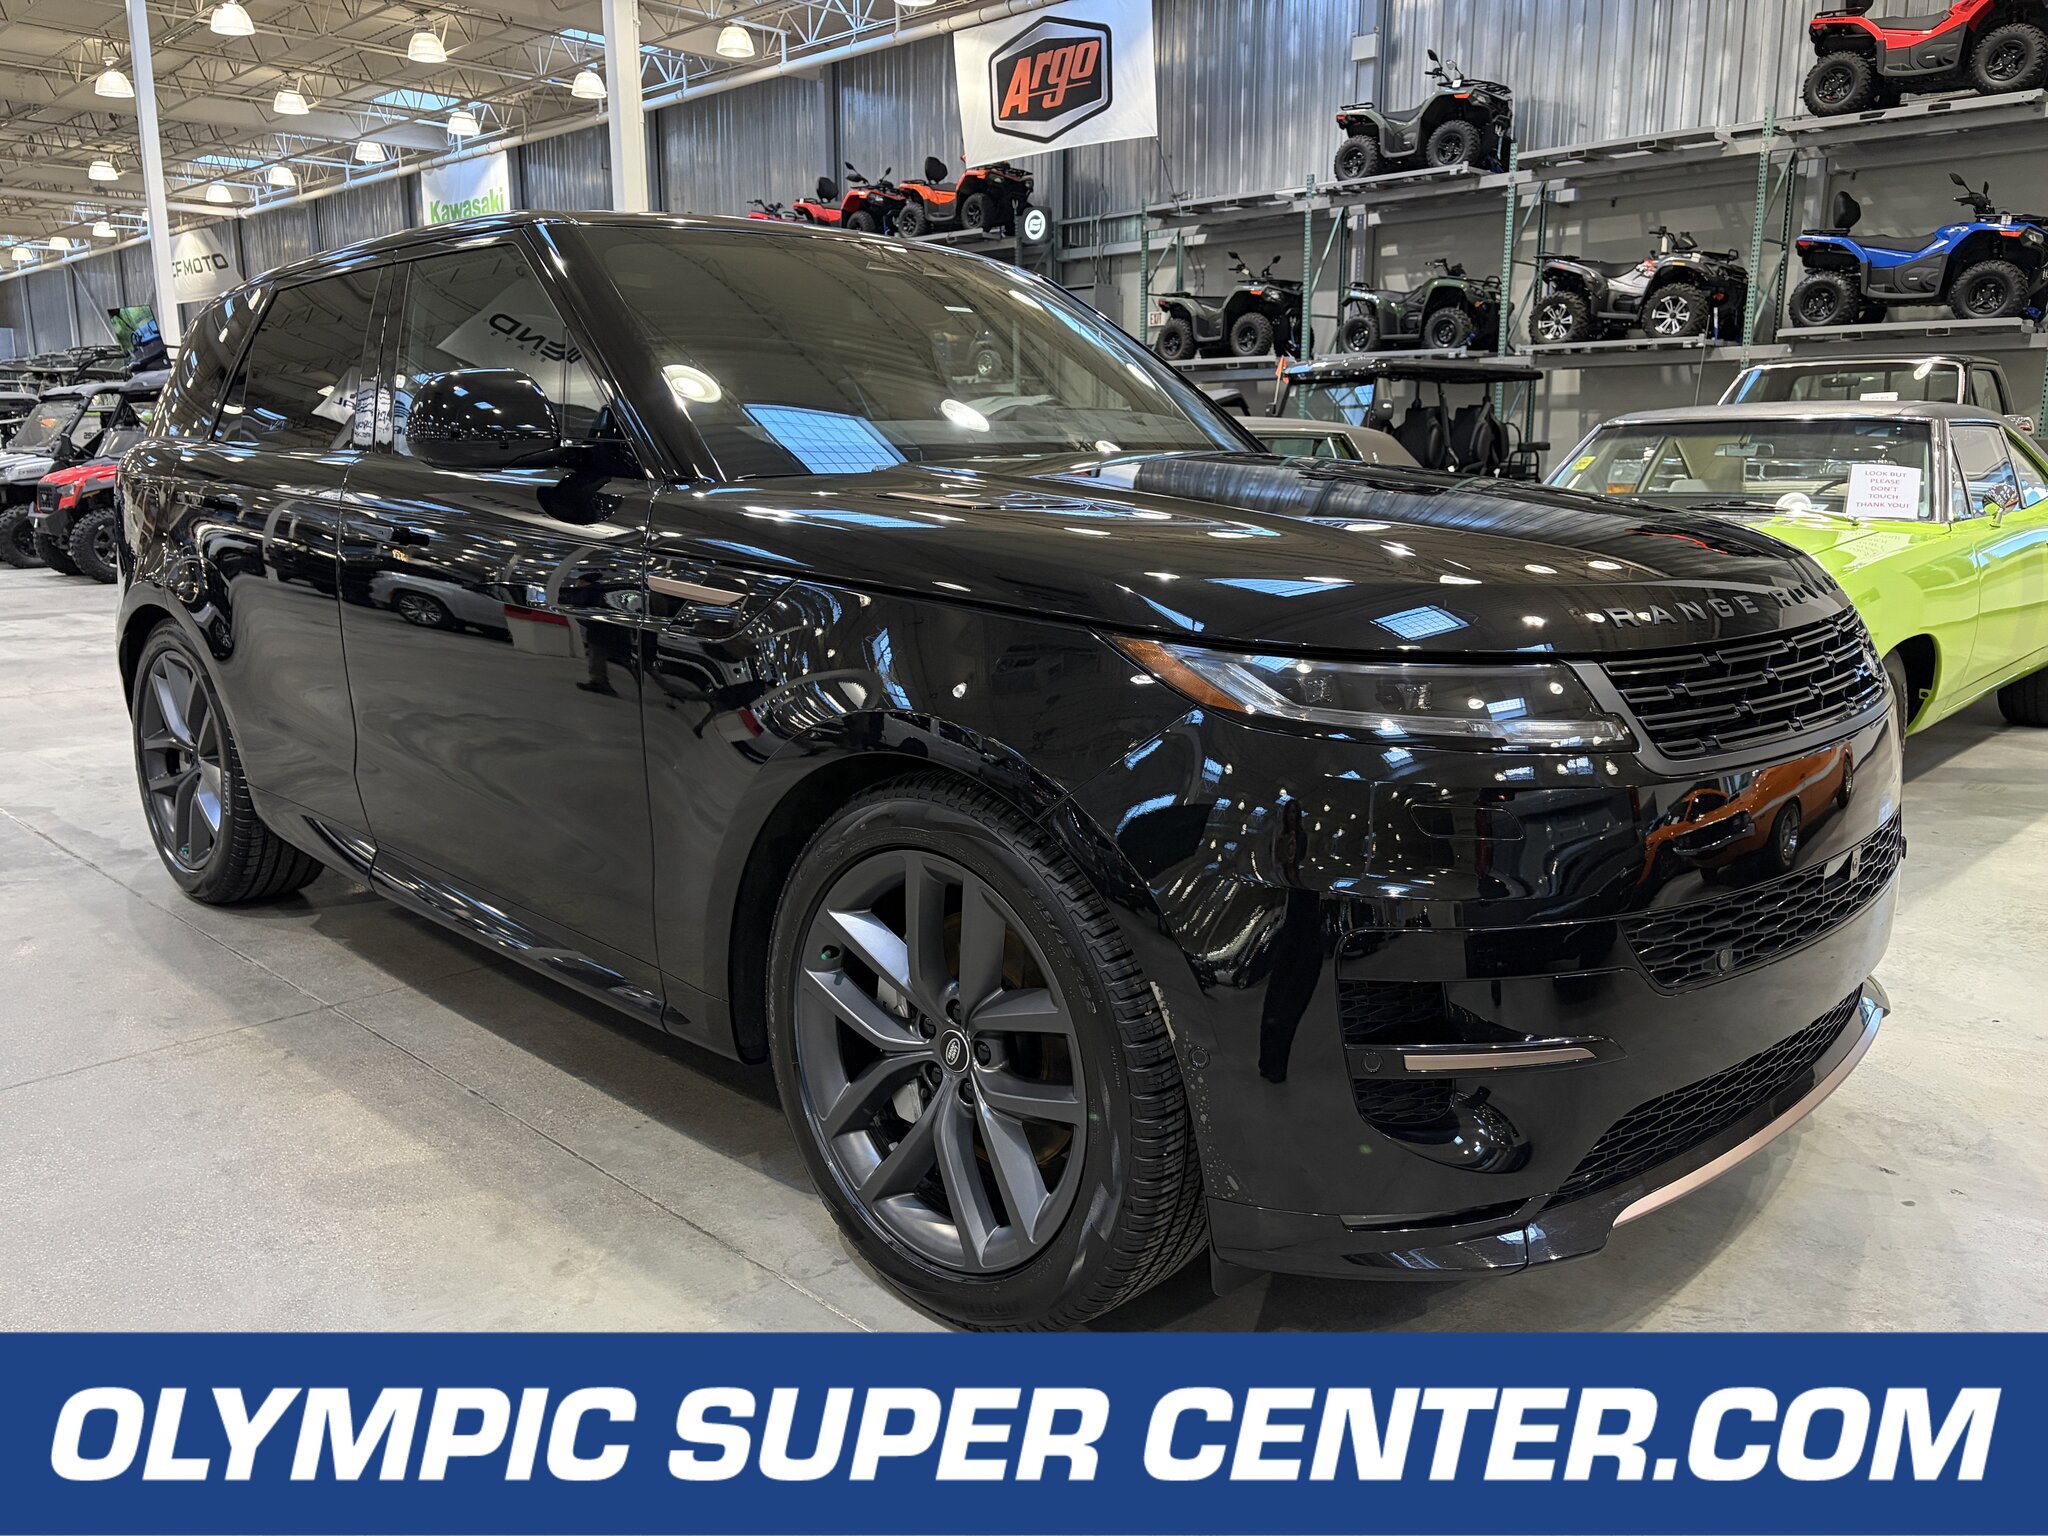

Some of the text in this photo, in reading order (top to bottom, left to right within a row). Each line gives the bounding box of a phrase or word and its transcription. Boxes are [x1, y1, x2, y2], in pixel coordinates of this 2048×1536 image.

[1000, 40, 1100, 119] Argo
[430, 187, 504, 224] Kawasaki
[1602, 575, 1838, 628] RANGE ROVE
